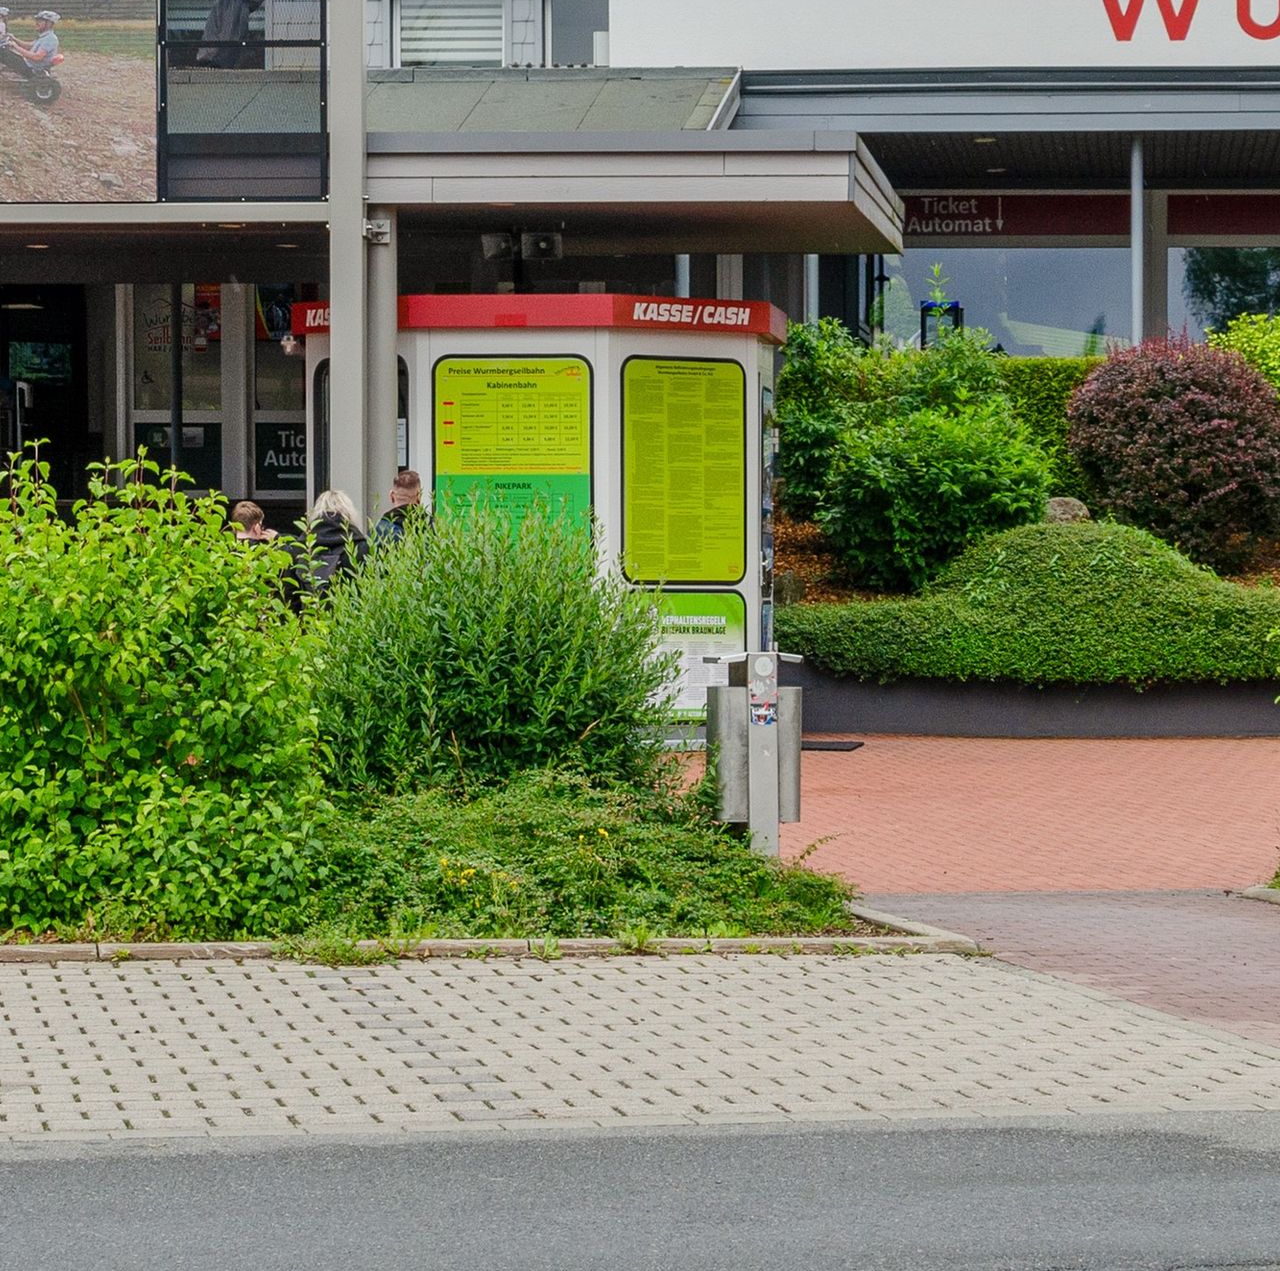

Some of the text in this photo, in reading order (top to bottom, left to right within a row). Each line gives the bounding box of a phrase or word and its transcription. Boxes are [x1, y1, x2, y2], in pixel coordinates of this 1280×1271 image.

[920, 197, 979, 214] Ticket
[907, 216, 992, 233] Automat
[633, 302, 751, 326] KASSE/CASH
[448, 367, 545, 377] Preise Wurmbergseilbahn
[486, 381, 537, 389] Kabinenbahn
